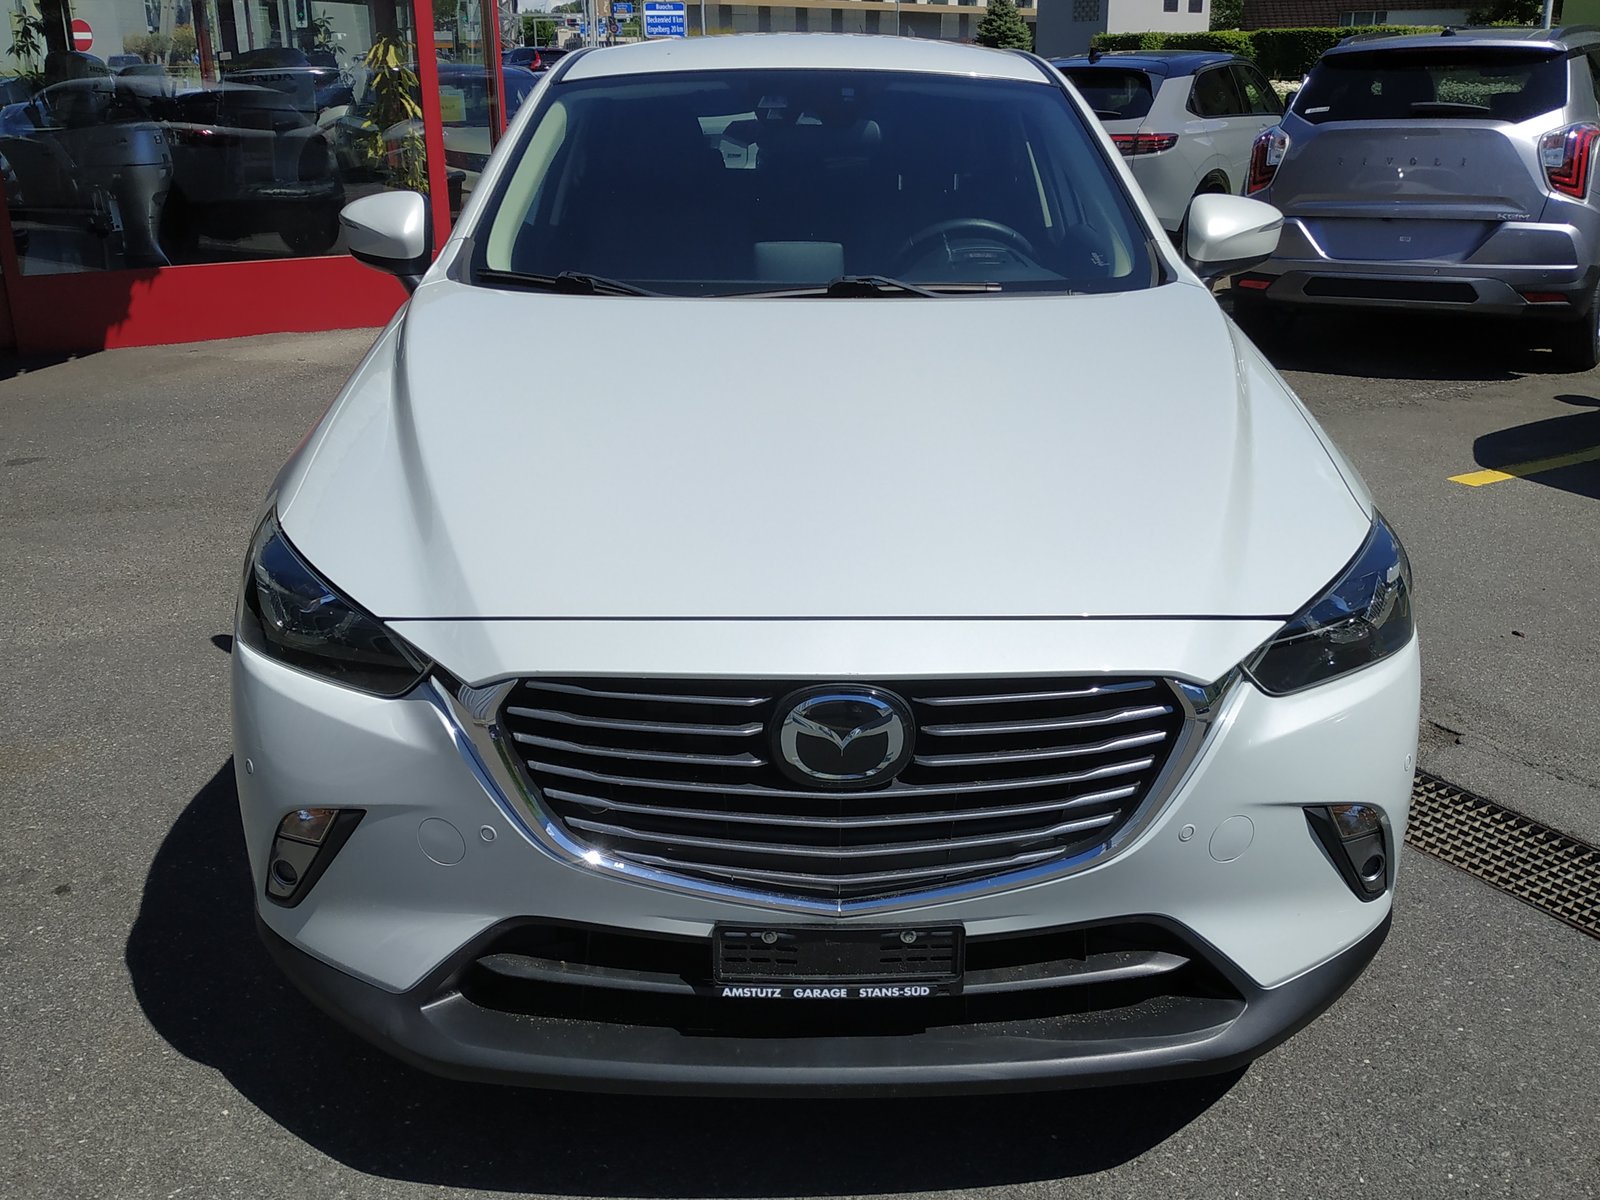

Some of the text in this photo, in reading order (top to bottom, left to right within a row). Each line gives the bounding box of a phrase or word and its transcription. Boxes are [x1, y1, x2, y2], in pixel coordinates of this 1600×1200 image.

[647, 25, 670, 34] Engelberg
[671, 25, 677, 33] 20
[722, 985, 930, 999] AMSTUTZ GARAGE STANS-SÜD
